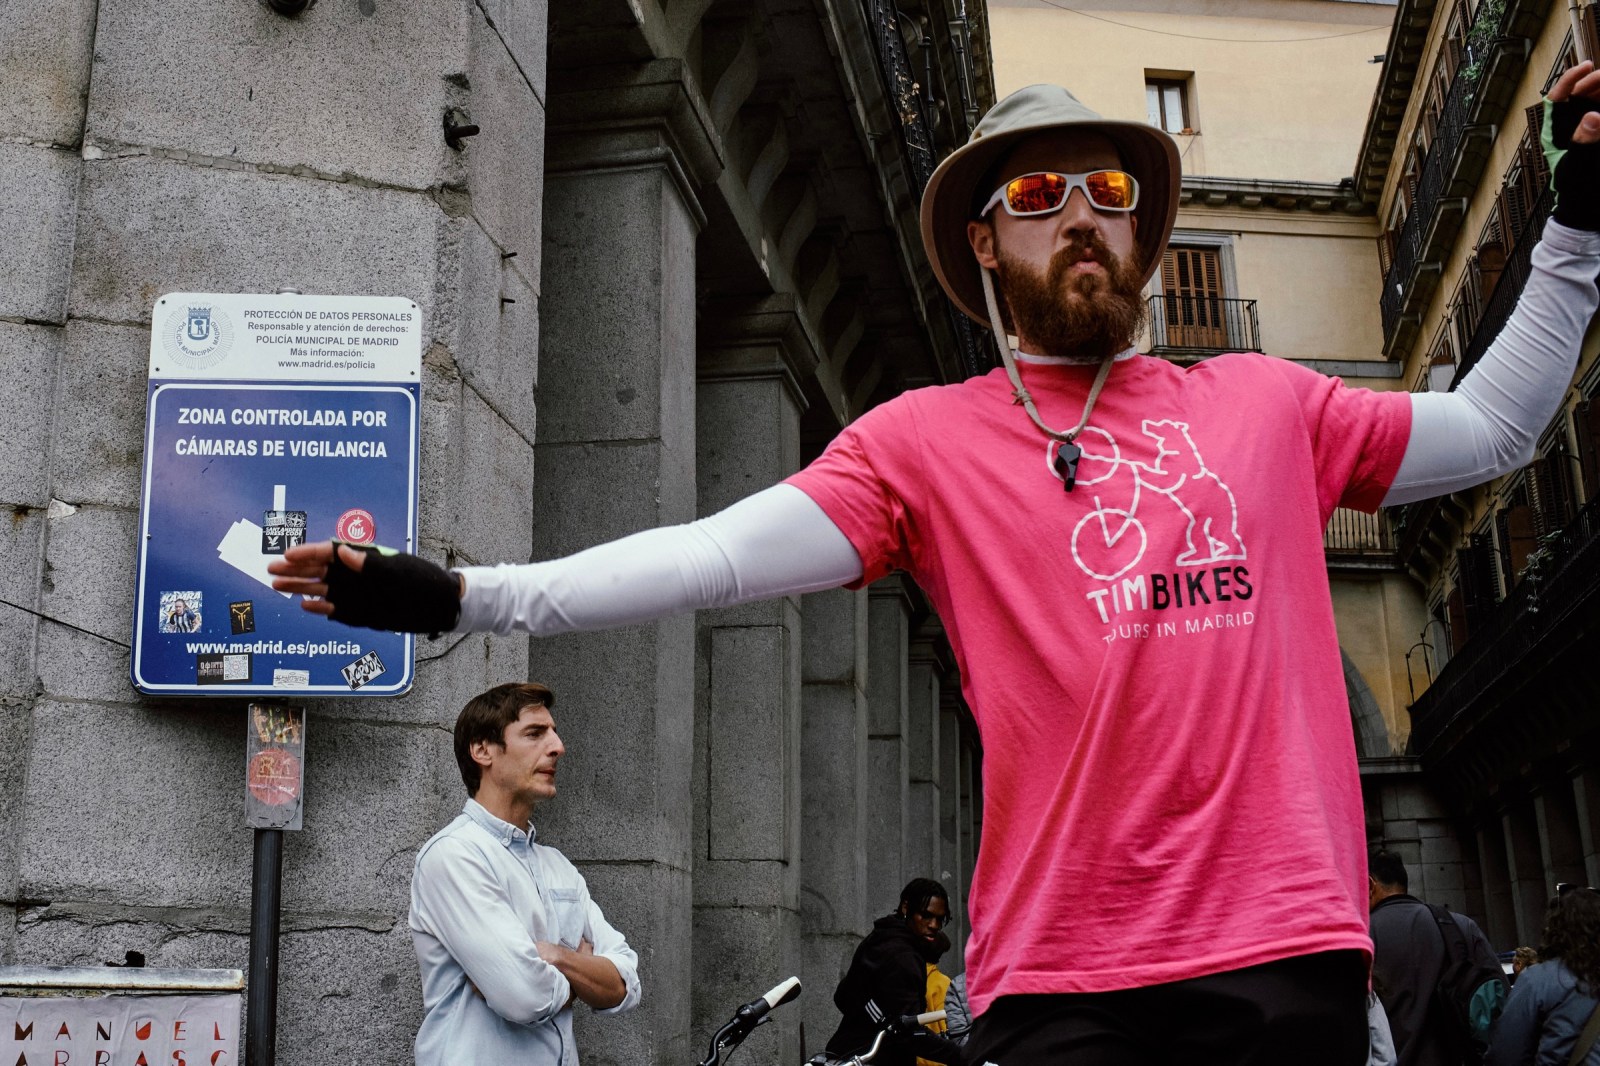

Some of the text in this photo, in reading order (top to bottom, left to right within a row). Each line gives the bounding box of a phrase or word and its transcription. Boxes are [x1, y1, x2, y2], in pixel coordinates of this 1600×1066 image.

[244, 309, 412, 322] PROTECCIÓN DE DATOS PERSONALES
[247, 322, 303, 332] Responsable
[314, 323, 350, 332] atención
[365, 324, 409, 333] derechos:
[181, 346, 214, 356] MUNICIPAL
[211, 321, 220, 345] MADRID
[256, 334, 399, 346] POLICÍA MUNICIPAL DE MADRID
[290, 348, 365, 357] Más información:
[278, 360, 376, 370] www.madrid.es/policia
[178, 408, 387, 427] ZONA CONTROLADA POR
[175, 435, 387, 458] CÁMARAS DE VIGILANCIA
[1157, 622, 1177, 638] IN
[1185, 611, 1255, 634] MADRID
[186, 641, 361, 657] www.madrid.es/policia
[15, 1020, 226, 1041] MANUEL
